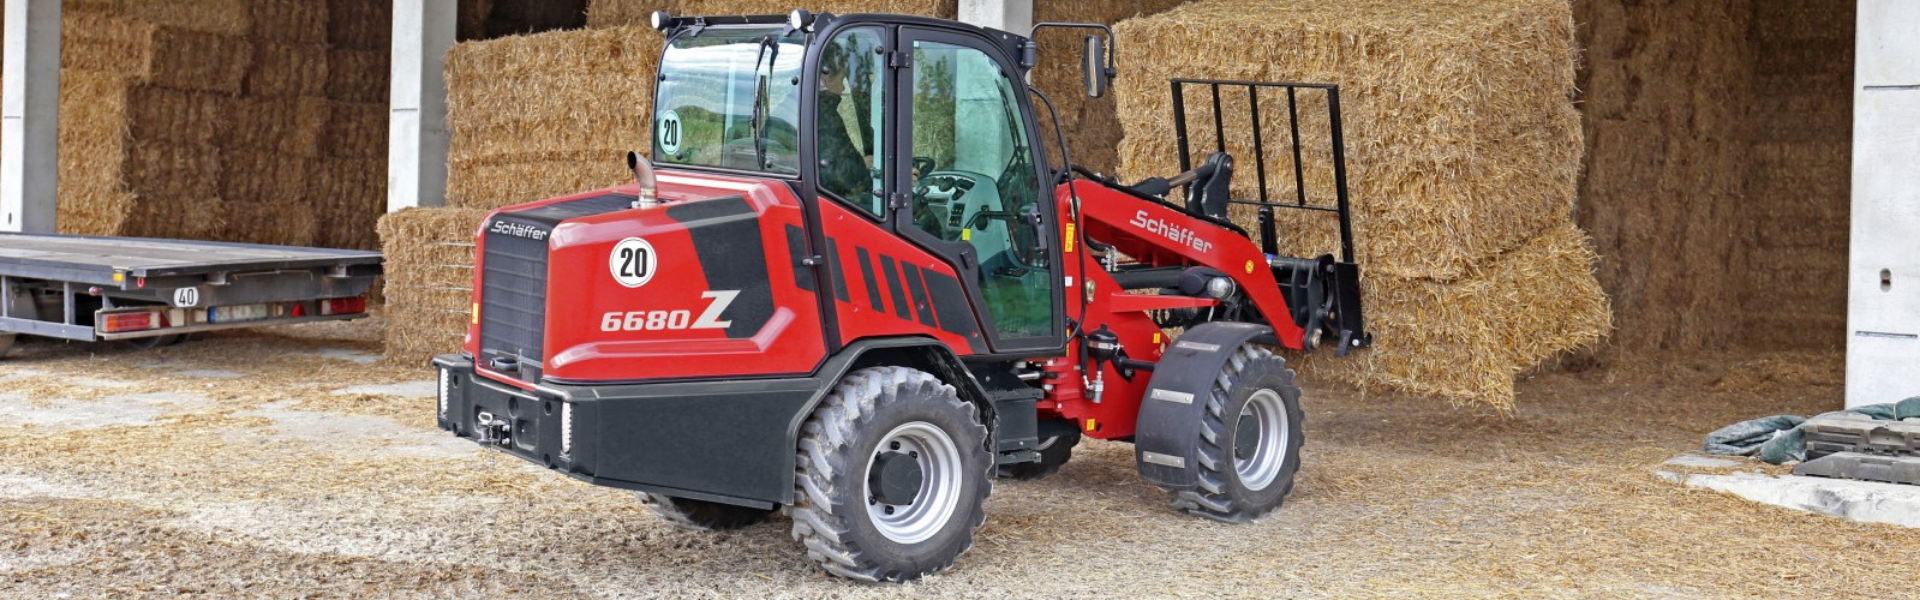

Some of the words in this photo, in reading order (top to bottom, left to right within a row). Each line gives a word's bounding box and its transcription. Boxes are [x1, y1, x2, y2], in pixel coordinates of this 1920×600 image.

[664, 119, 677, 146] 20
[490, 220, 547, 241] Schäffer
[1130, 210, 1212, 253] Schäffer
[620, 247, 648, 278] 20
[179, 289, 194, 304] 40
